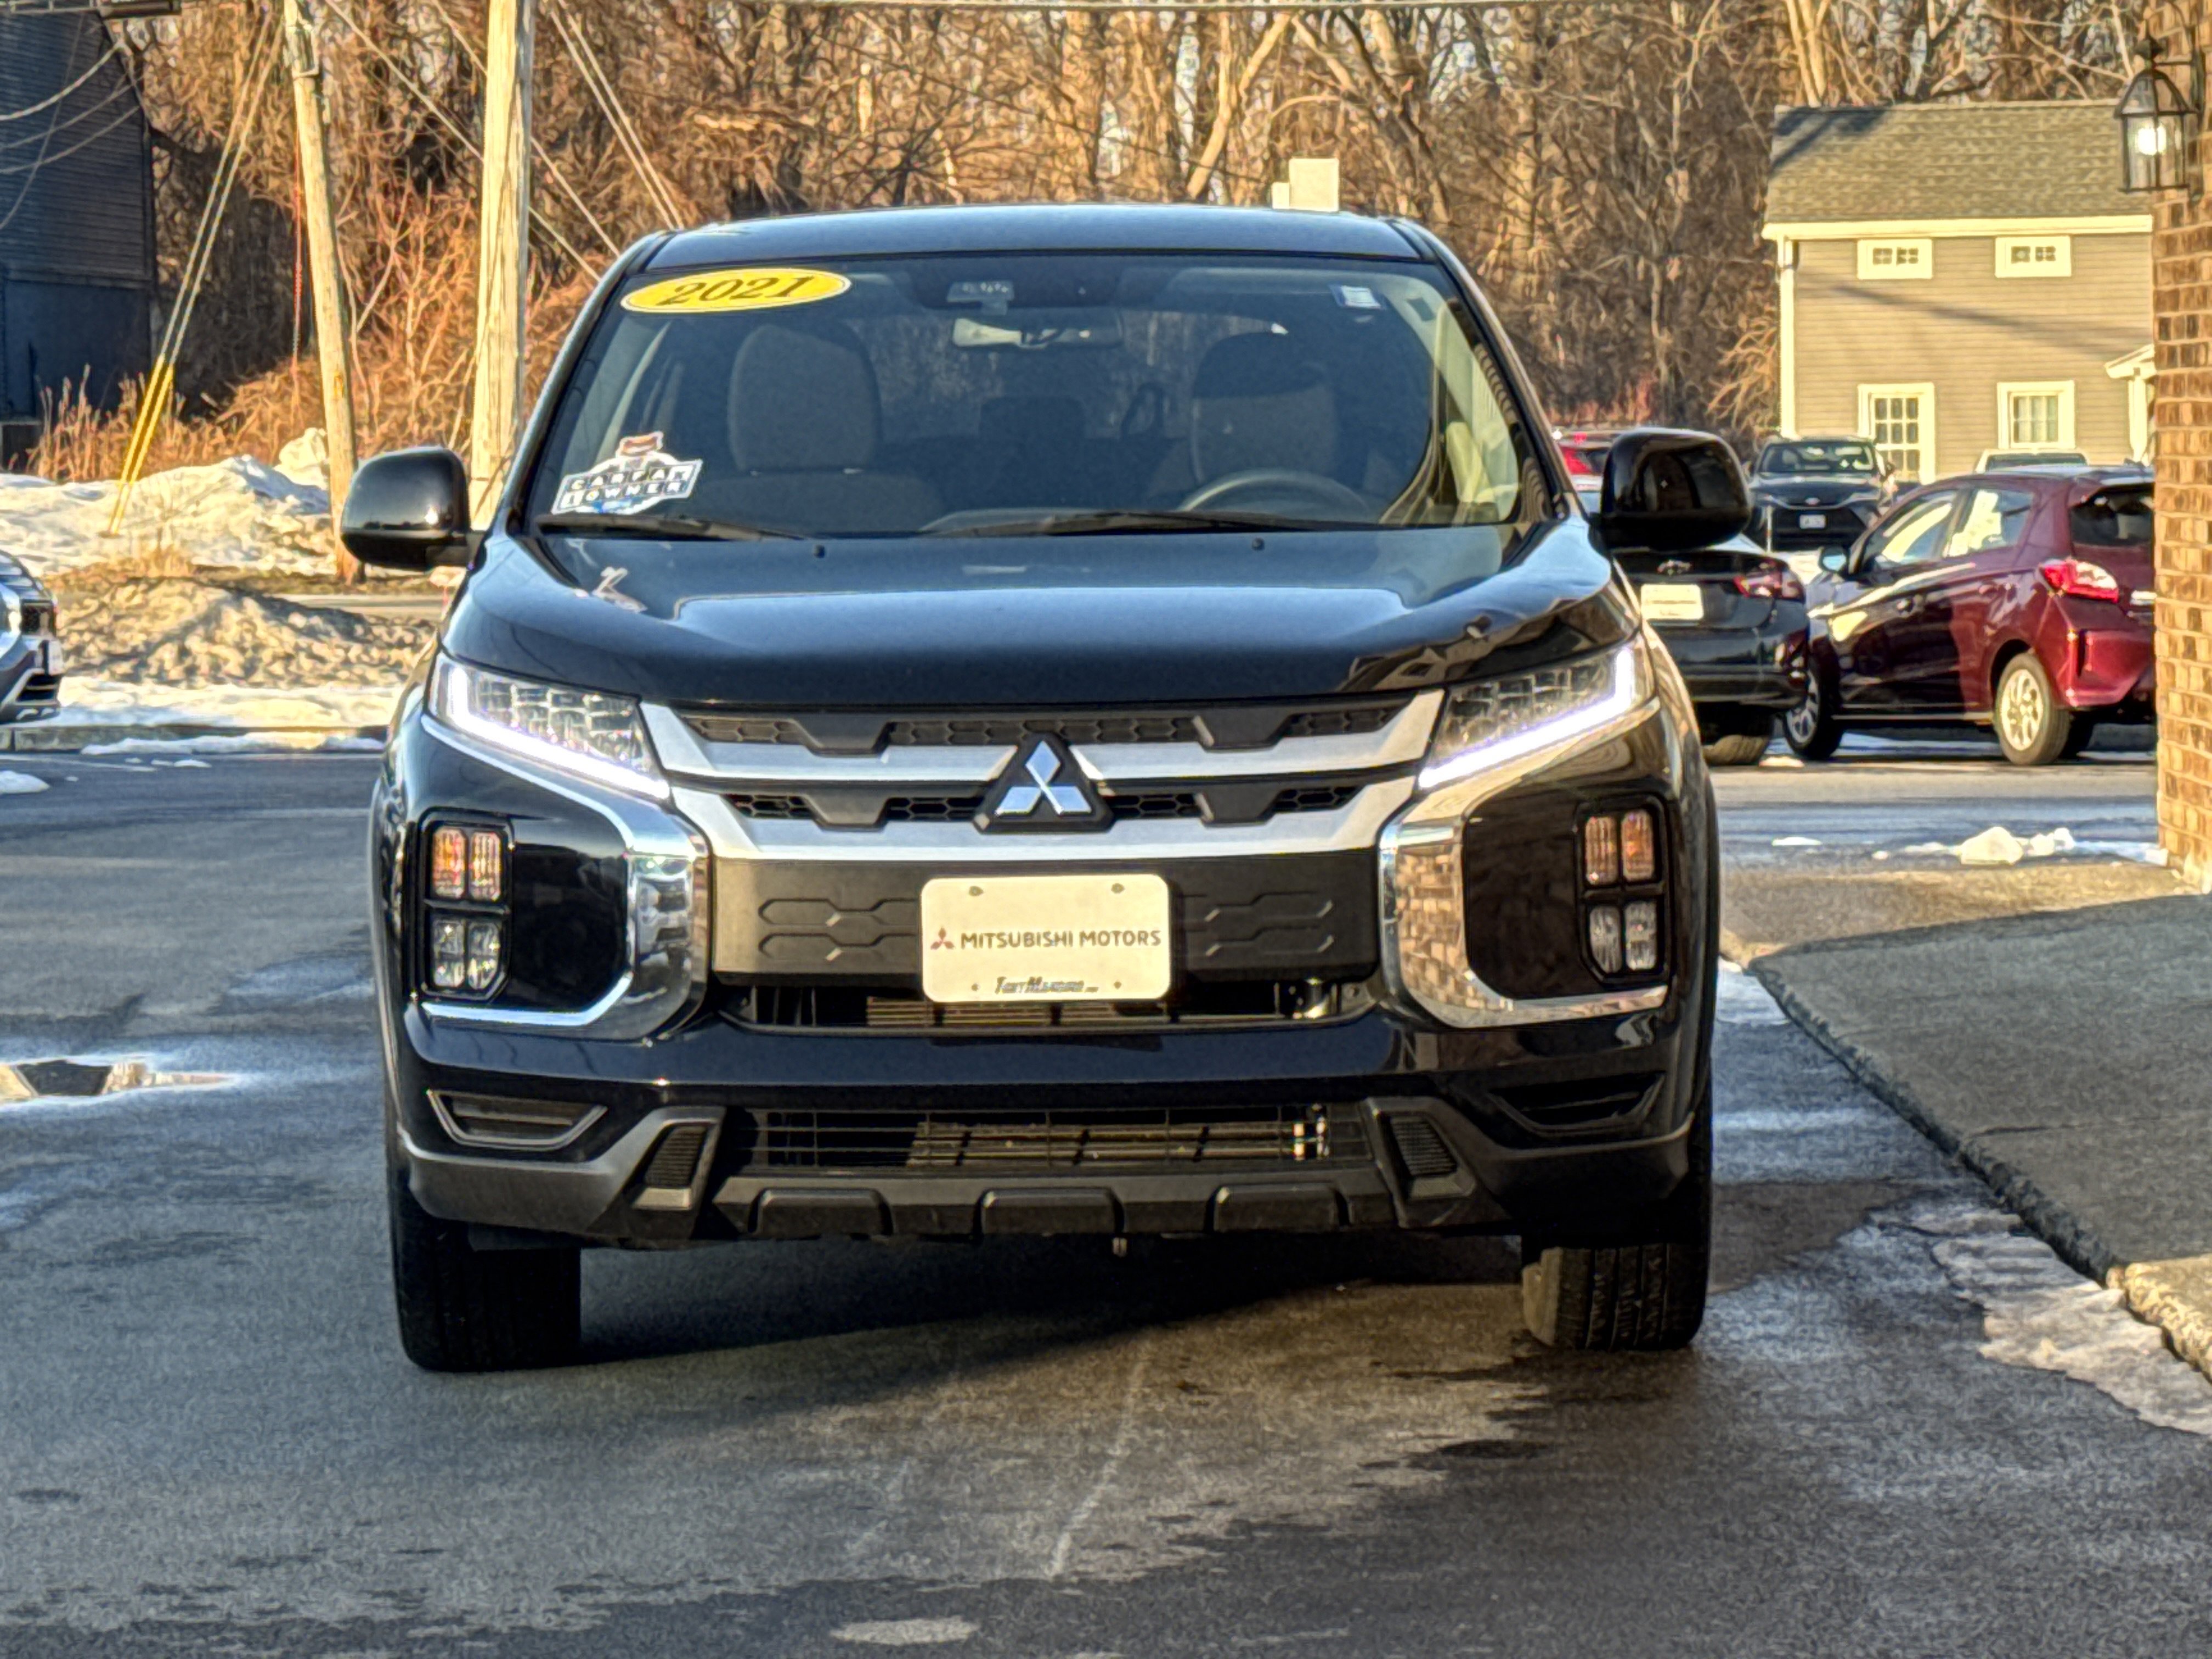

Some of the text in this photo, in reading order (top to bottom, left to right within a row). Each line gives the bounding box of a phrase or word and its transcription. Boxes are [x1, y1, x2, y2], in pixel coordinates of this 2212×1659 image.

[656, 275, 815, 306] 2021
[960, 930, 1161, 949] MITSUBISHI MOTORS
